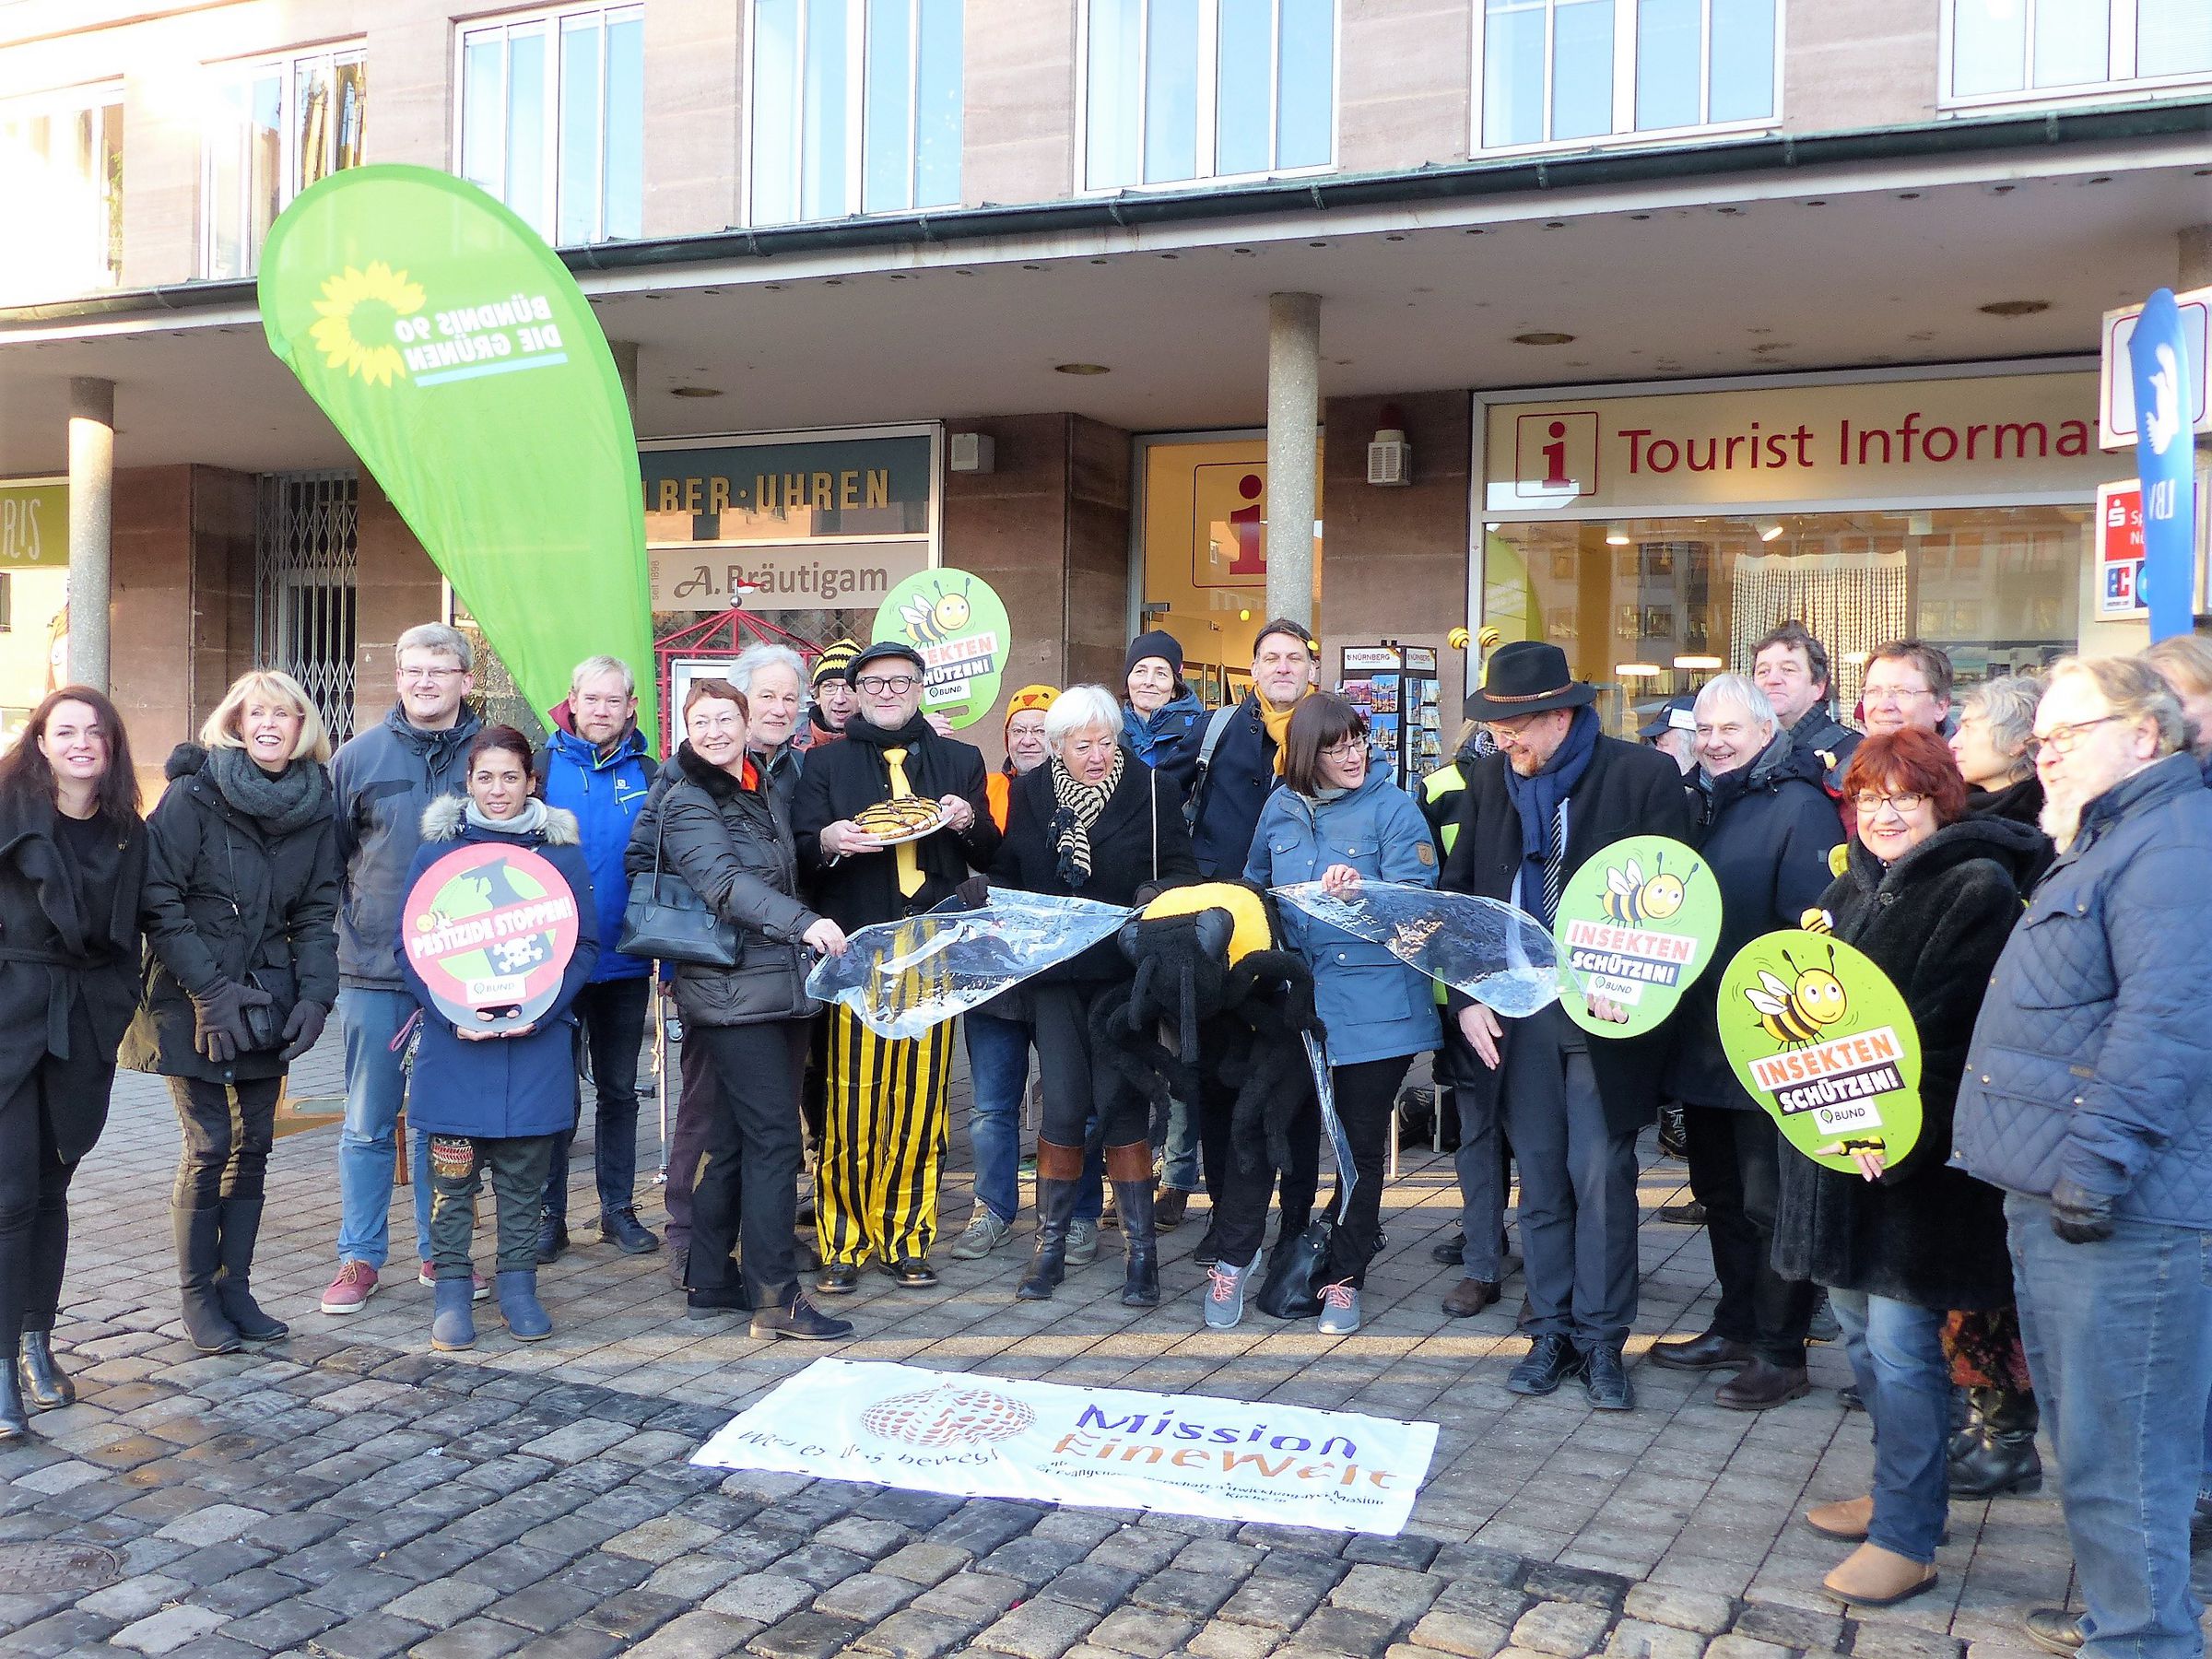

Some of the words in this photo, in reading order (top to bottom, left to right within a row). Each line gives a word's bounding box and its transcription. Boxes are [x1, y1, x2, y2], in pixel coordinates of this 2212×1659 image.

[1618, 422, 1814, 474] Tourist
[1840, 412, 2118, 465] Informa
[756, 468, 888, 514] UHREN
[650, 559, 660, 581] 1898
[921, 636, 993, 665] EKTEN
[939, 685, 962, 696] BUND
[411, 918, 495, 959] PESTIZIDE
[494, 896, 574, 936] STOPPEN!
[1571, 924, 1690, 960] INSEKTEN
[1571, 950, 1675, 983] SCHÜTZEN!
[486, 982, 515, 994] BUND
[1605, 982, 1632, 994] BUND
[1756, 1033, 1895, 1087] INSEKTEN
[1778, 1066, 1900, 1113] SCHÜTZEN!
[1834, 1107, 1865, 1120] BUND
[1076, 1403, 1358, 1459] Mission
